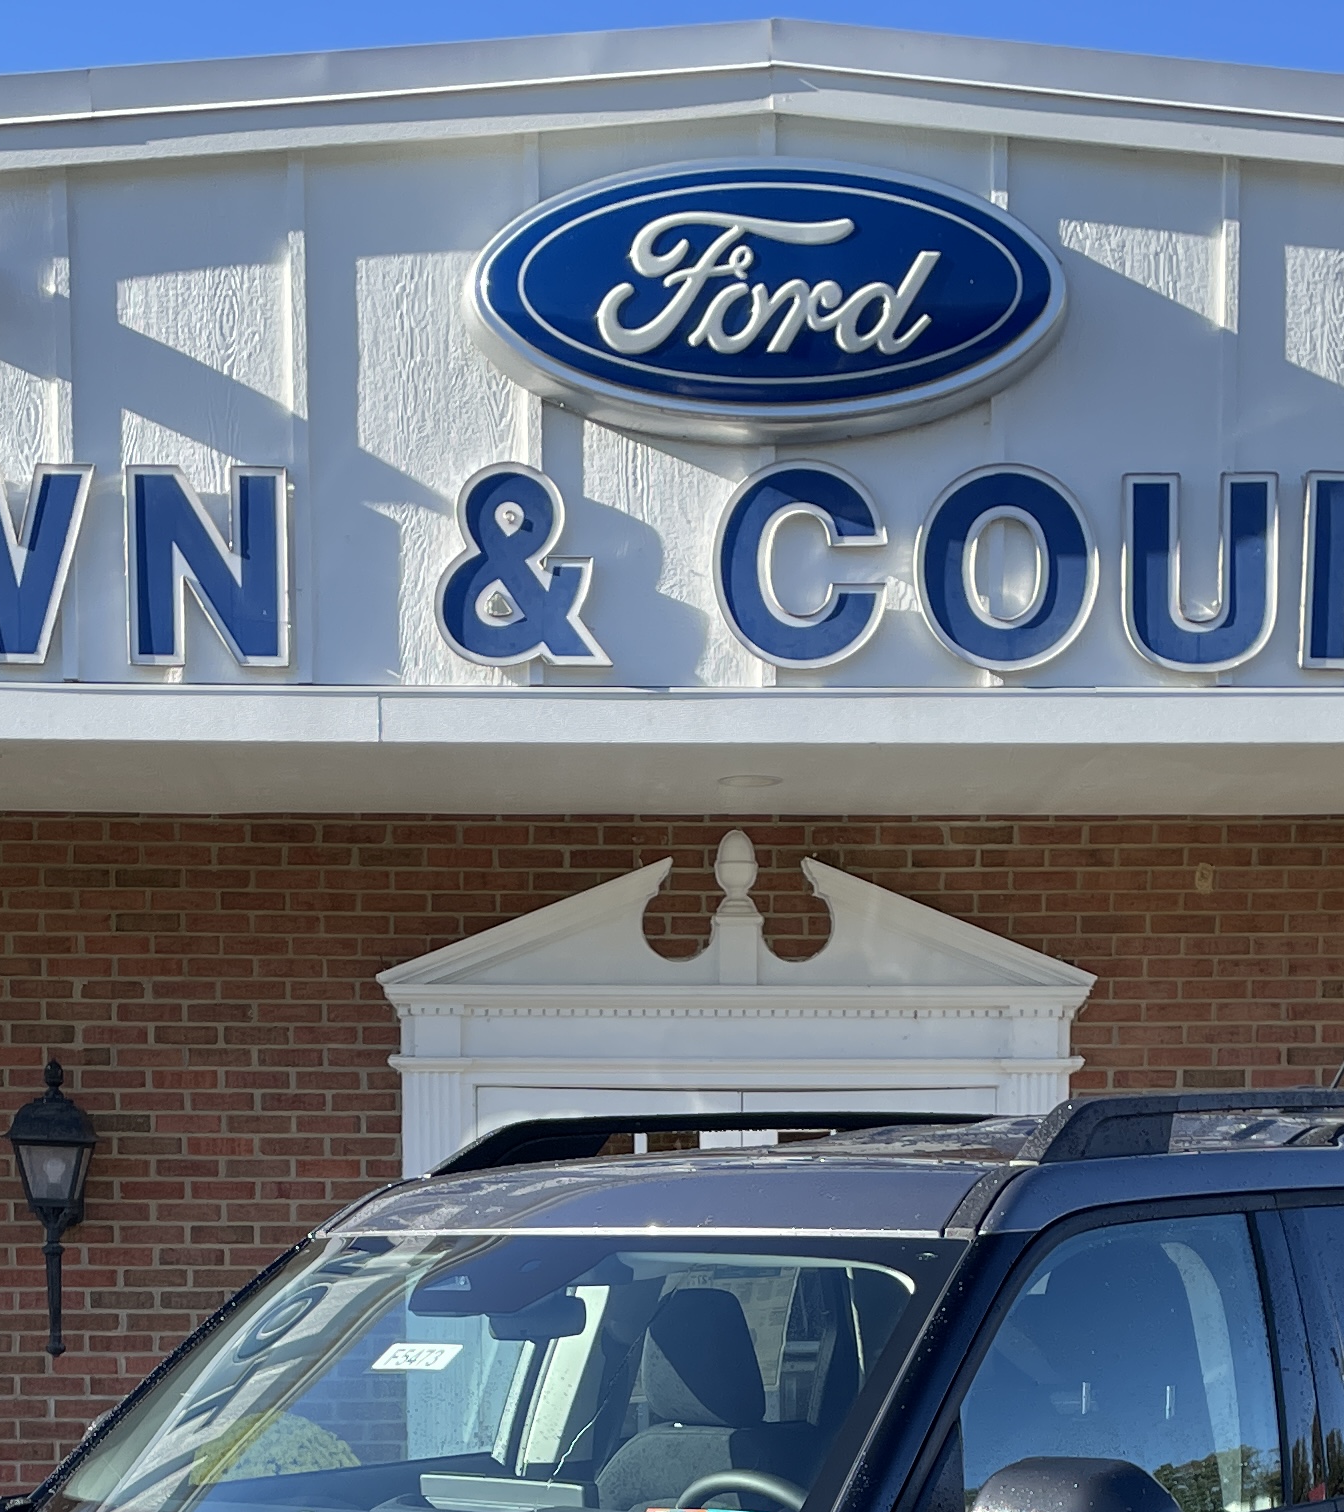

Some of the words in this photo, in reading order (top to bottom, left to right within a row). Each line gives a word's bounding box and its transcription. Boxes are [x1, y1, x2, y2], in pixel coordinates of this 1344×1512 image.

[597, 210, 942, 355] Ford
[435, 460, 613, 668] &
[384, 1348, 445, 1367] F5473
